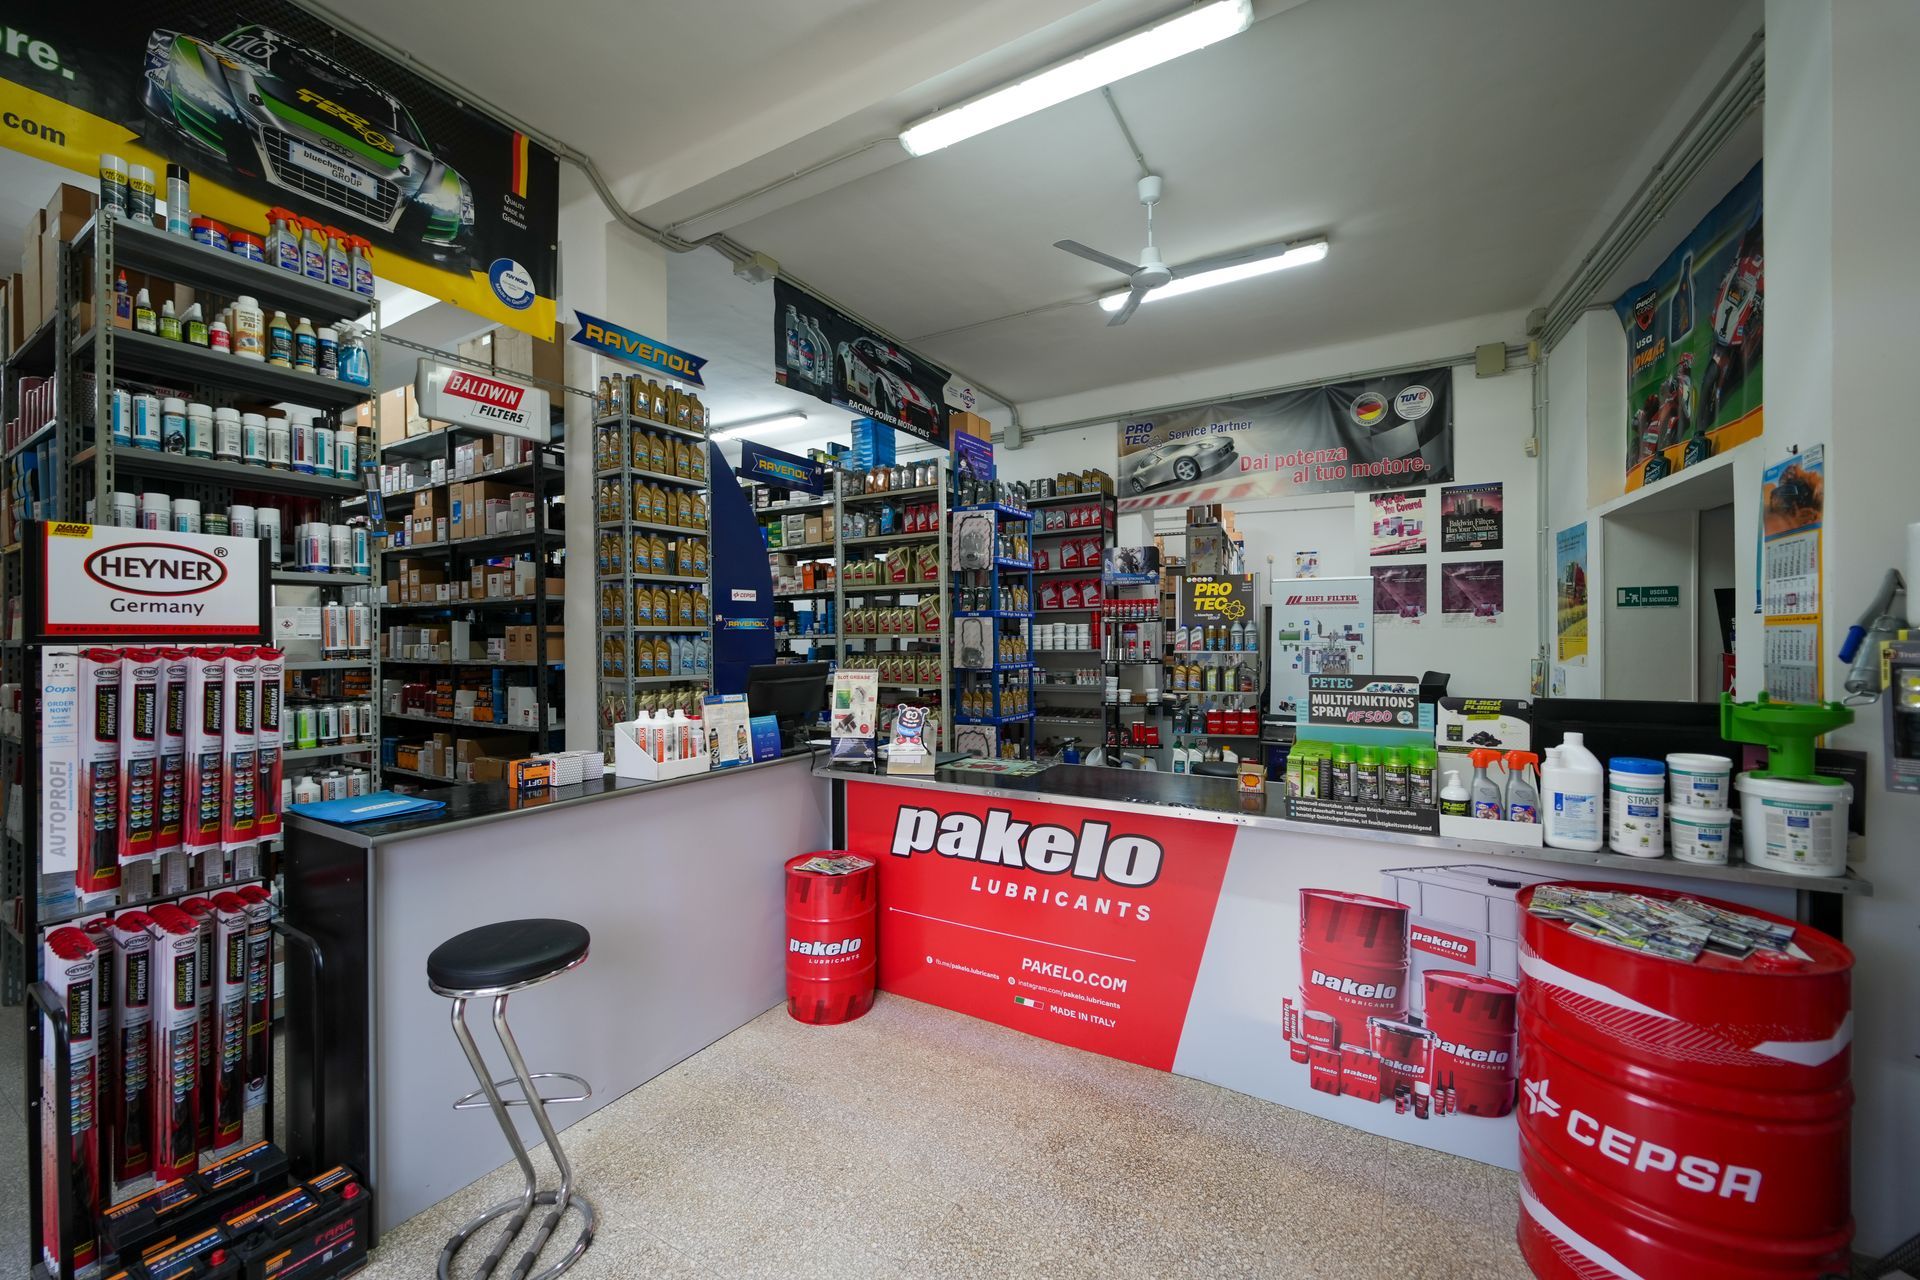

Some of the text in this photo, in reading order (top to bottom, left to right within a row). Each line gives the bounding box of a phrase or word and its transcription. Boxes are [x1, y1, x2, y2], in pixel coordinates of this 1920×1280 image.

[0, 25, 76, 82] re.
[304, 150, 345, 174] bluechem
[332, 170, 362, 188] GROUP
[585, 323, 695, 376] RAVENOL
[450, 375, 519, 405] BALDWIN
[960, 392, 976, 405] FUCHS
[479, 404, 524, 424] FILTERS
[849, 400, 930, 438] RACING POWER MOTOR OILS
[1126, 420, 1252, 440] PRO Service Partner
[1125, 434, 1150, 446] TEC
[1240, 447, 1348, 472] Dai potenza
[758, 460, 808, 480] RAVENOL
[1292, 456, 1431, 484] al tuo motore.
[1383, 499, 1422, 515] You Covered
[1449, 518, 1495, 528] Baldwin Filters
[100, 556, 214, 582] HEYNER
[1194, 583, 1232, 596] PRO
[110, 598, 204, 616] Germany
[1194, 597, 1228, 610] TEC
[45, 685, 76, 693] Oops
[1312, 678, 1353, 688] PETEC
[1312, 694, 1414, 708] MULTIFUNKTIONS
[108, 694, 116, 735] PREMIUM
[145, 693, 154, 734] PREMIUM
[1312, 706, 1348, 718] SPRAY
[50, 761, 66, 858] AUTOPROFI
[1627, 796, 1659, 805] STRAPS
[1367, 807, 1417, 816] Kriecheigenschaften
[892, 806, 1163, 887] pakelo
[970, 876, 1151, 922] LUBRICANTS
[227, 916, 247, 927] HEYNER
[126, 935, 151, 947] HEYNER
[174, 937, 197, 949] HEYNER
[790, 938, 862, 956] pakelo
[1412, 931, 1469, 953] pakelo
[809, 953, 860, 964] LUBRICANTS
[1429, 945, 1467, 959] LUBRICANTS
[67, 965, 94, 976] HEYNER
[935, 959, 1000, 980] fb.me/pakelo.lubricants
[1021, 958, 1127, 993] PAKELO.COM
[138, 959, 147, 1000] PREMIUM
[186, 962, 194, 1002] PREMIUM
[1311, 969, 1398, 999] pakelo
[1018, 980, 1121, 1009] instagram.com/pakelo.lubricants
[1339, 995, 1394, 1008] LUBRICANTS
[80, 990, 91, 1034] PREMIUM
[1050, 1005, 1116, 1028] MADE IN ITALY
[1306, 1033, 1330, 1043] pakelo
[1314, 1065, 1338, 1074] pakelo
[1454, 1058, 1506, 1071] LUBRICANTS
[1344, 1068, 1378, 1081] pakelo
[1567, 1109, 1763, 1203] CEPSA
